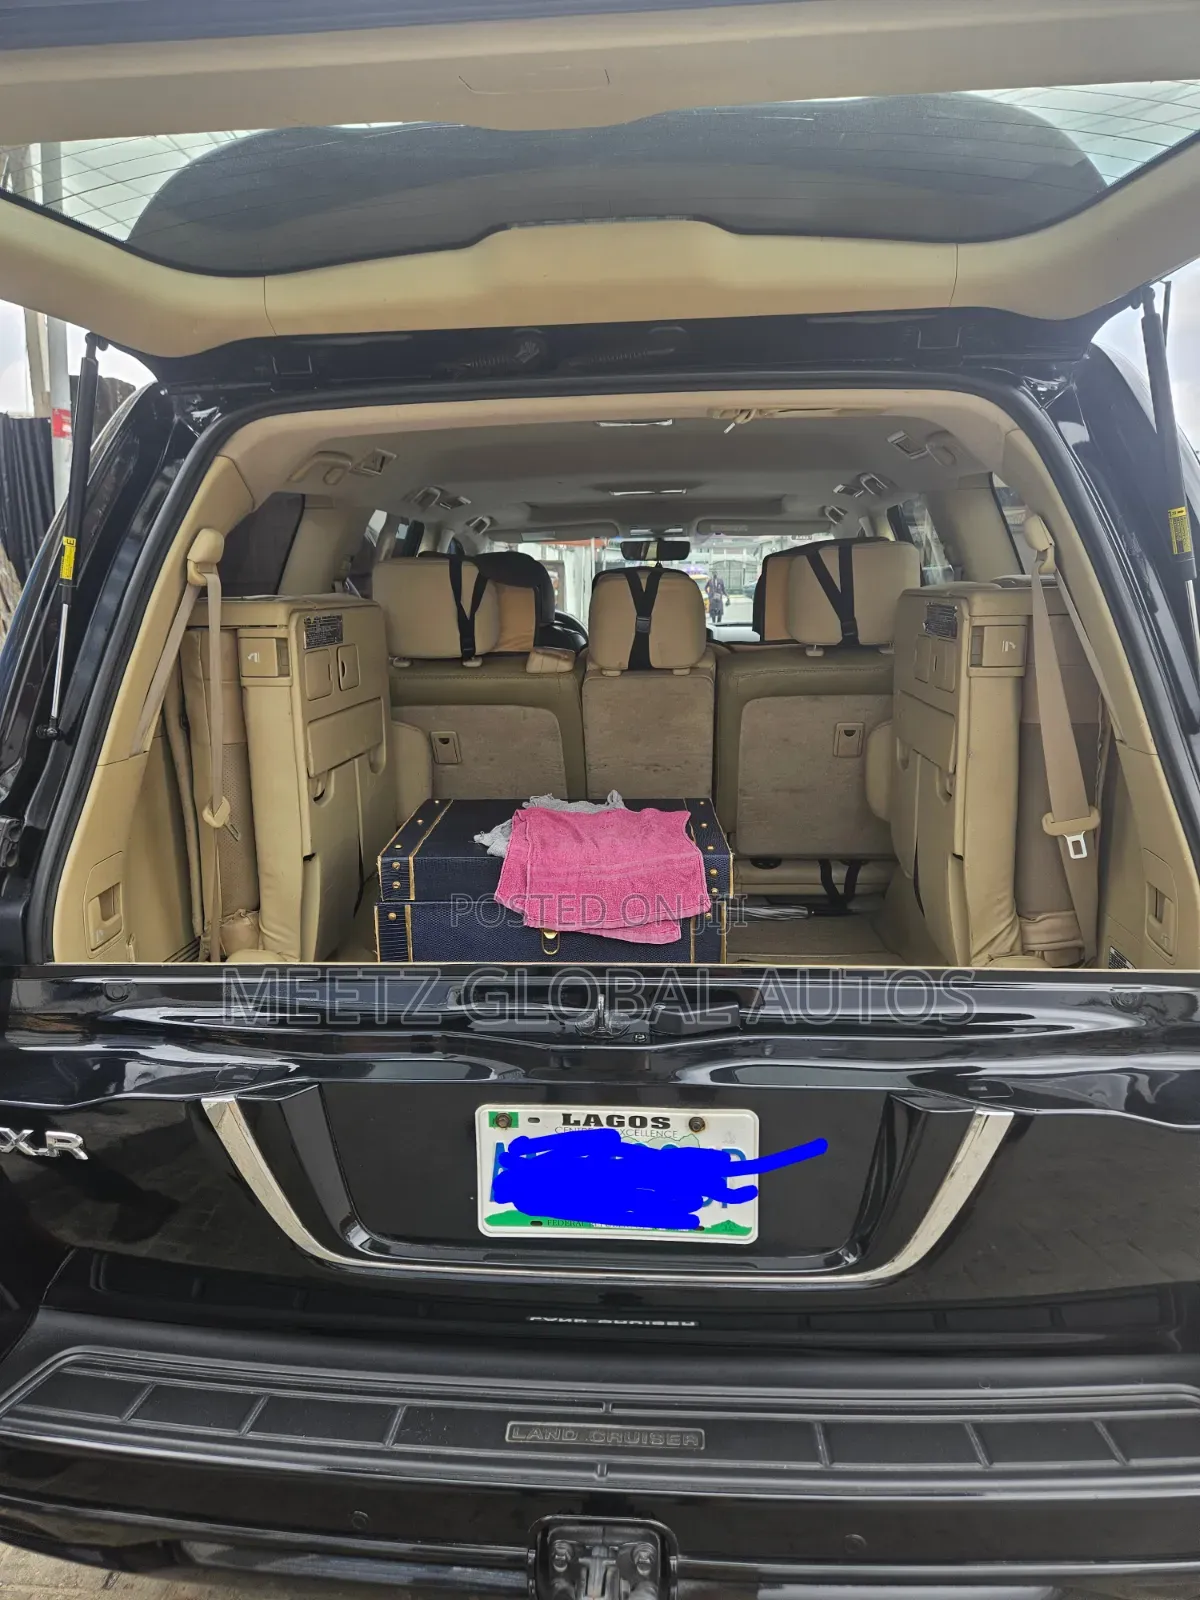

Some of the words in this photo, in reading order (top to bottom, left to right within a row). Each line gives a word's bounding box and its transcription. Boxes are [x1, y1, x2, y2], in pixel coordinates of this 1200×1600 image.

[561, 1112, 671, 1130] LAGOS
[620, 1128, 678, 1138] XCELLENCE
[511, 1426, 578, 1441] LAND
[589, 1429, 699, 1447] CRUISER
